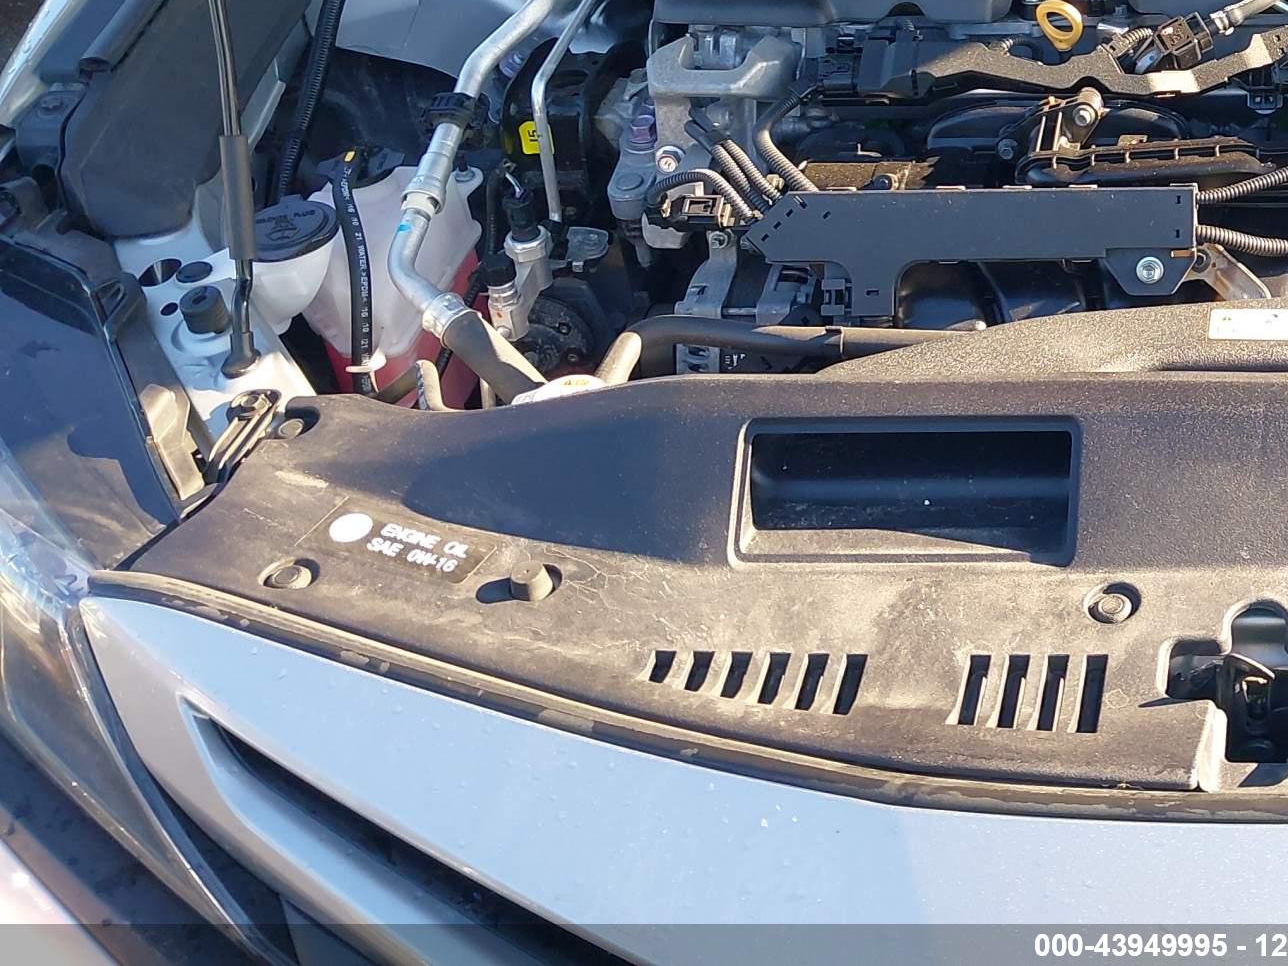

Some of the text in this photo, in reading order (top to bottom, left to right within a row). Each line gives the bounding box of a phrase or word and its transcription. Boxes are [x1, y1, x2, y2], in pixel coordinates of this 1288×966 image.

[366, 537, 458, 572] SAE 0W-16
[380, 523, 470, 559] ENGINE OIL
